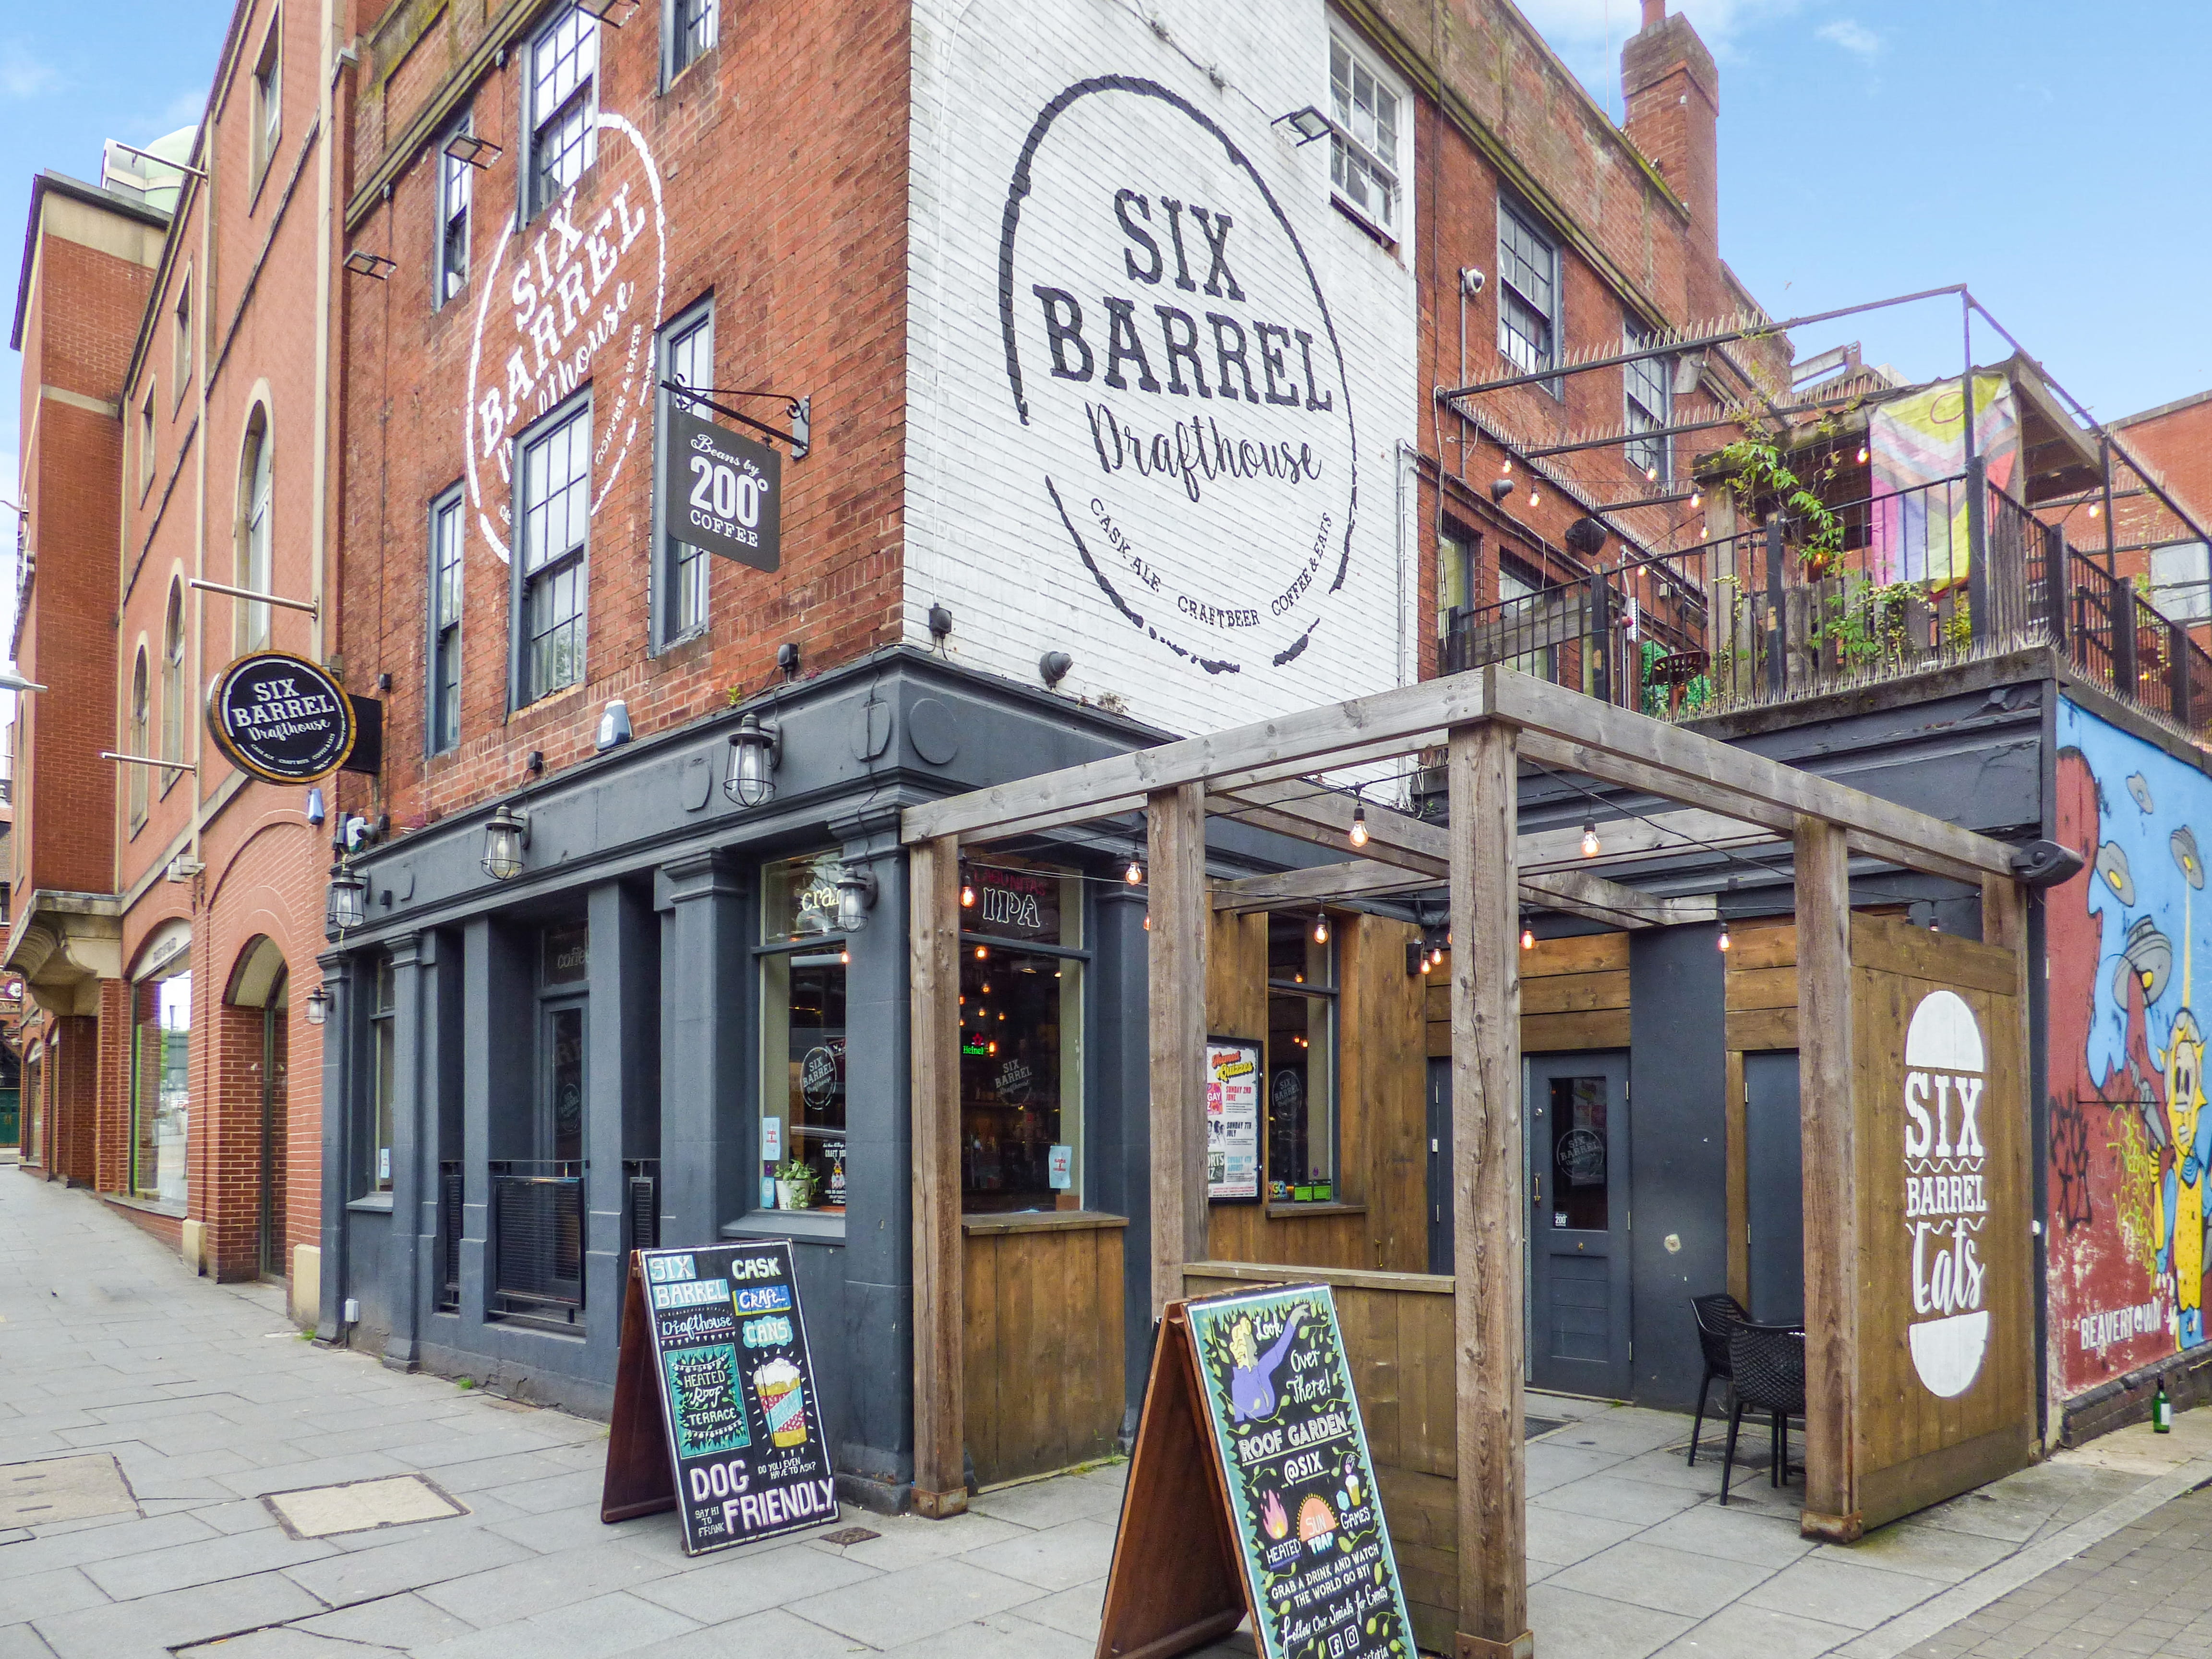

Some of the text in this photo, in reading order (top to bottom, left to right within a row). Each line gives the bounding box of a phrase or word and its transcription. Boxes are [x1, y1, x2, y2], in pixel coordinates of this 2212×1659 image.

[1114, 189, 1246, 302] SIX
[512, 186, 583, 332] SIX
[479, 182, 646, 458] BARREL
[1033, 284, 1332, 412] BARREL
[595, 396, 626, 466] COFFEE
[690, 433, 760, 477] Beans by
[1085, 402, 1322, 502] Drafthouse
[690, 509, 758, 547] COFFEE
[1091, 497, 1131, 559] CASK
[1130, 556, 1161, 593] ALE
[1271, 568, 1312, 616] COFFEE
[1310, 556, 1319, 572] &
[1316, 512, 1333, 559] EATS
[253, 678, 300, 702] SIX
[231, 695, 336, 727] BARREL
[247, 719, 331, 741] Drafthouse
[251, 744, 264, 755] CASK
[313, 746, 328, 760] COFFEE
[974, 869, 1046, 896] LAGUNITAS
[982, 887, 1041, 927] IPA
[808, 1056, 823, 1072] SIX
[1002, 1058, 1020, 1073] SIX
[1212, 1050, 1241, 1069] Themed
[1215, 1061, 1254, 1083] Quizzes
[803, 1062, 834, 1088] BARREL
[995, 1067, 1033, 1088] BARREL
[1207, 1092, 1221, 1102] GAY
[1226, 1085, 1252, 1094] SUNDAY 2ND
[1226, 1121, 1243, 1130] SUNDAY
[1905, 1071, 1984, 1158] SIX
[1560, 1142, 1599, 1161] BARREL
[1568, 1136, 1585, 1149] SIX
[1905, 1174, 1987, 1217] BARREL
[650, 1255, 693, 1281] SIX
[732, 1257, 782, 1280] CASK
[1912, 1216, 1985, 1316] Eats
[655, 1280, 729, 1308] BARREL
[662, 1313, 733, 1340] Drafthouse
[745, 1321, 789, 1343] CANS
[1253, 1312, 1283, 1341] Look
[2080, 1296, 2162, 1350] BEAVERTOWN
[1290, 1349, 1321, 1372] Over
[684, 1370, 725, 1388] HEATED
[1286, 1368, 1331, 1404] There!
[690, 1385, 724, 1408] Roof
[686, 1407, 737, 1426] TERRACE
[1238, 1411, 1348, 1463] ROOF GARDEN
[757, 1456, 801, 1475] DO YOU EVEN
[770, 1461, 817, 1480] HAVE TO ASK?
[1284, 1451, 1323, 1486] @SIX
[689, 1459, 750, 1502] DOG
[695, 1505, 720, 1519] SAY HI
[722, 1477, 835, 1535] FRIENDLY
[1340, 1506, 1371, 1530] GAMES
[698, 1522, 725, 1538] FRANK
[701, 1516, 712, 1526] TO
[1305, 1513, 1327, 1536] SUN
[1266, 1538, 1301, 1564] HEATED
[1307, 1531, 1334, 1556] TRAP
[1271, 1542, 1380, 1600] GRAB A DRINK AND WATCH
[1293, 1564, 1370, 1608] THE WORLD GO BY!
[1281, 1584, 1388, 1659] Follow Our Socials for Events
